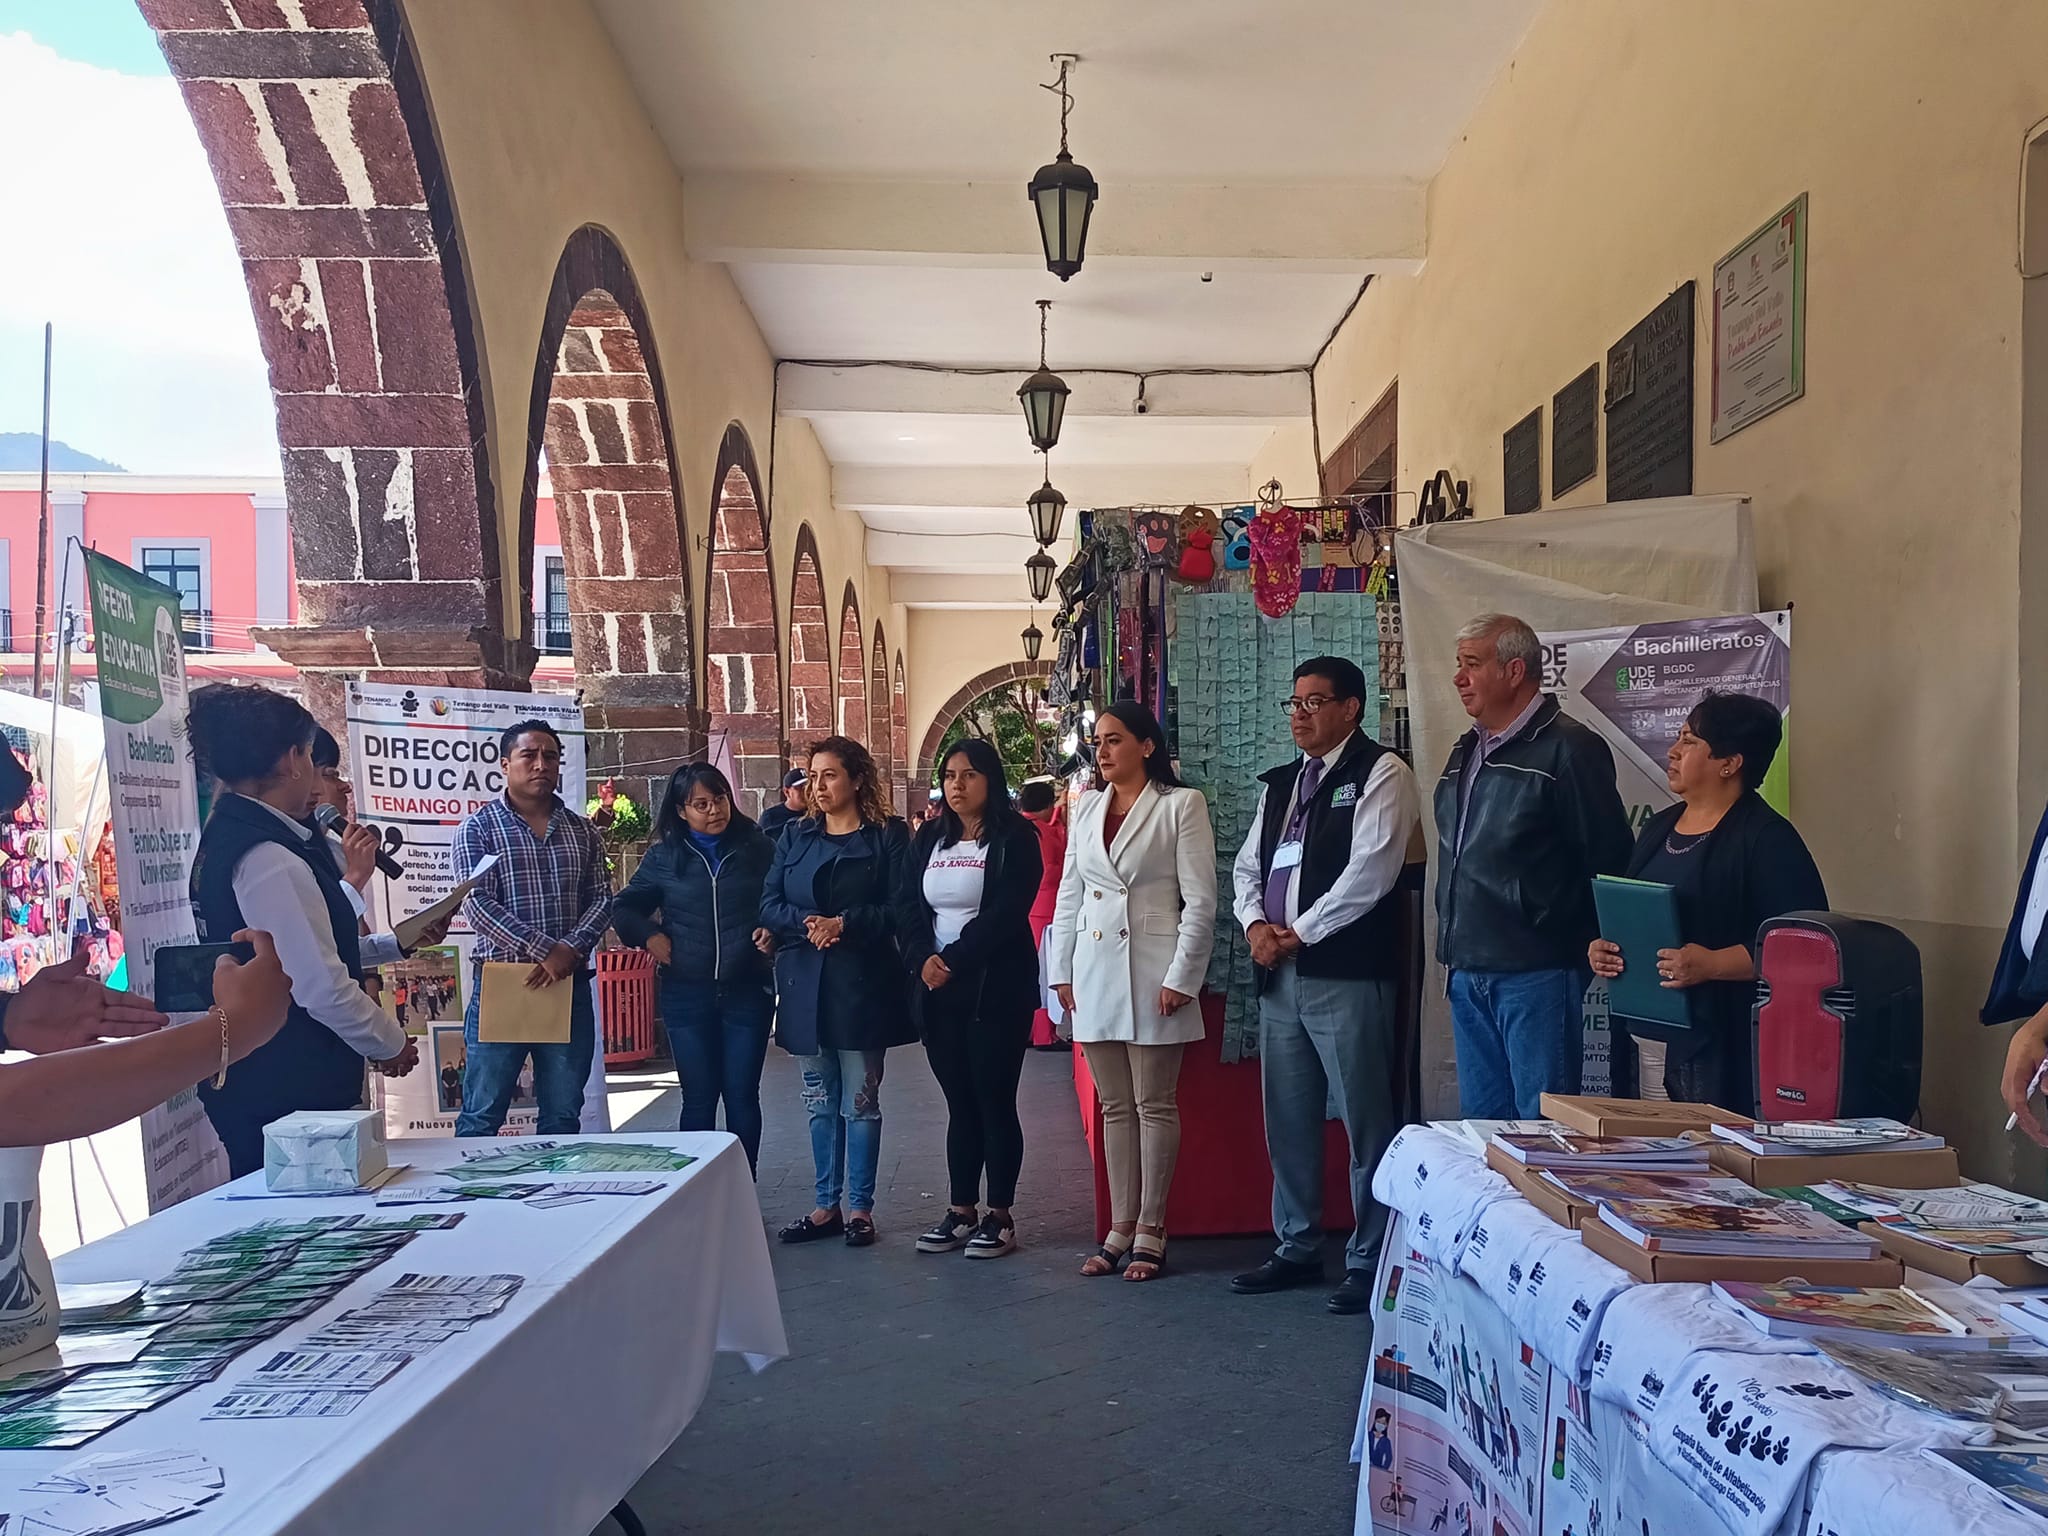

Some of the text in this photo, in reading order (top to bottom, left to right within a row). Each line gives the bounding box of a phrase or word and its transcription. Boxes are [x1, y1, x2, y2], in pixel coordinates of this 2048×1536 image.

[1634, 633, 1766, 657] Bachilleratos
[101, 631, 157, 678] EDUCATIVA
[1541, 643, 1567, 666] DE
[1628, 665, 1656, 678] UDE
[1663, 663, 1696, 674] BGDC
[1542, 667, 1567, 688] EX
[1629, 678, 1656, 690] MEX
[1664, 675, 1720, 687] BACHILLERATO
[1721, 674, 1756, 682] GENERAL
[127, 732, 175, 764] Bachillerato
[364, 734, 499, 764] DIRECCIÓ
[371, 795, 461, 815] TENANGO
[408, 849, 432, 859] Libre,
[402, 860, 436, 871] derecho
[947, 860, 985, 869] ANGELE
[417, 873, 455, 882] fundame
[407, 884, 436, 894] social;
[1713, 1459, 1724, 1475] de
[1722, 1466, 1767, 1515] Alfabetización
[1725, 1487, 1751, 1518] Educativo
